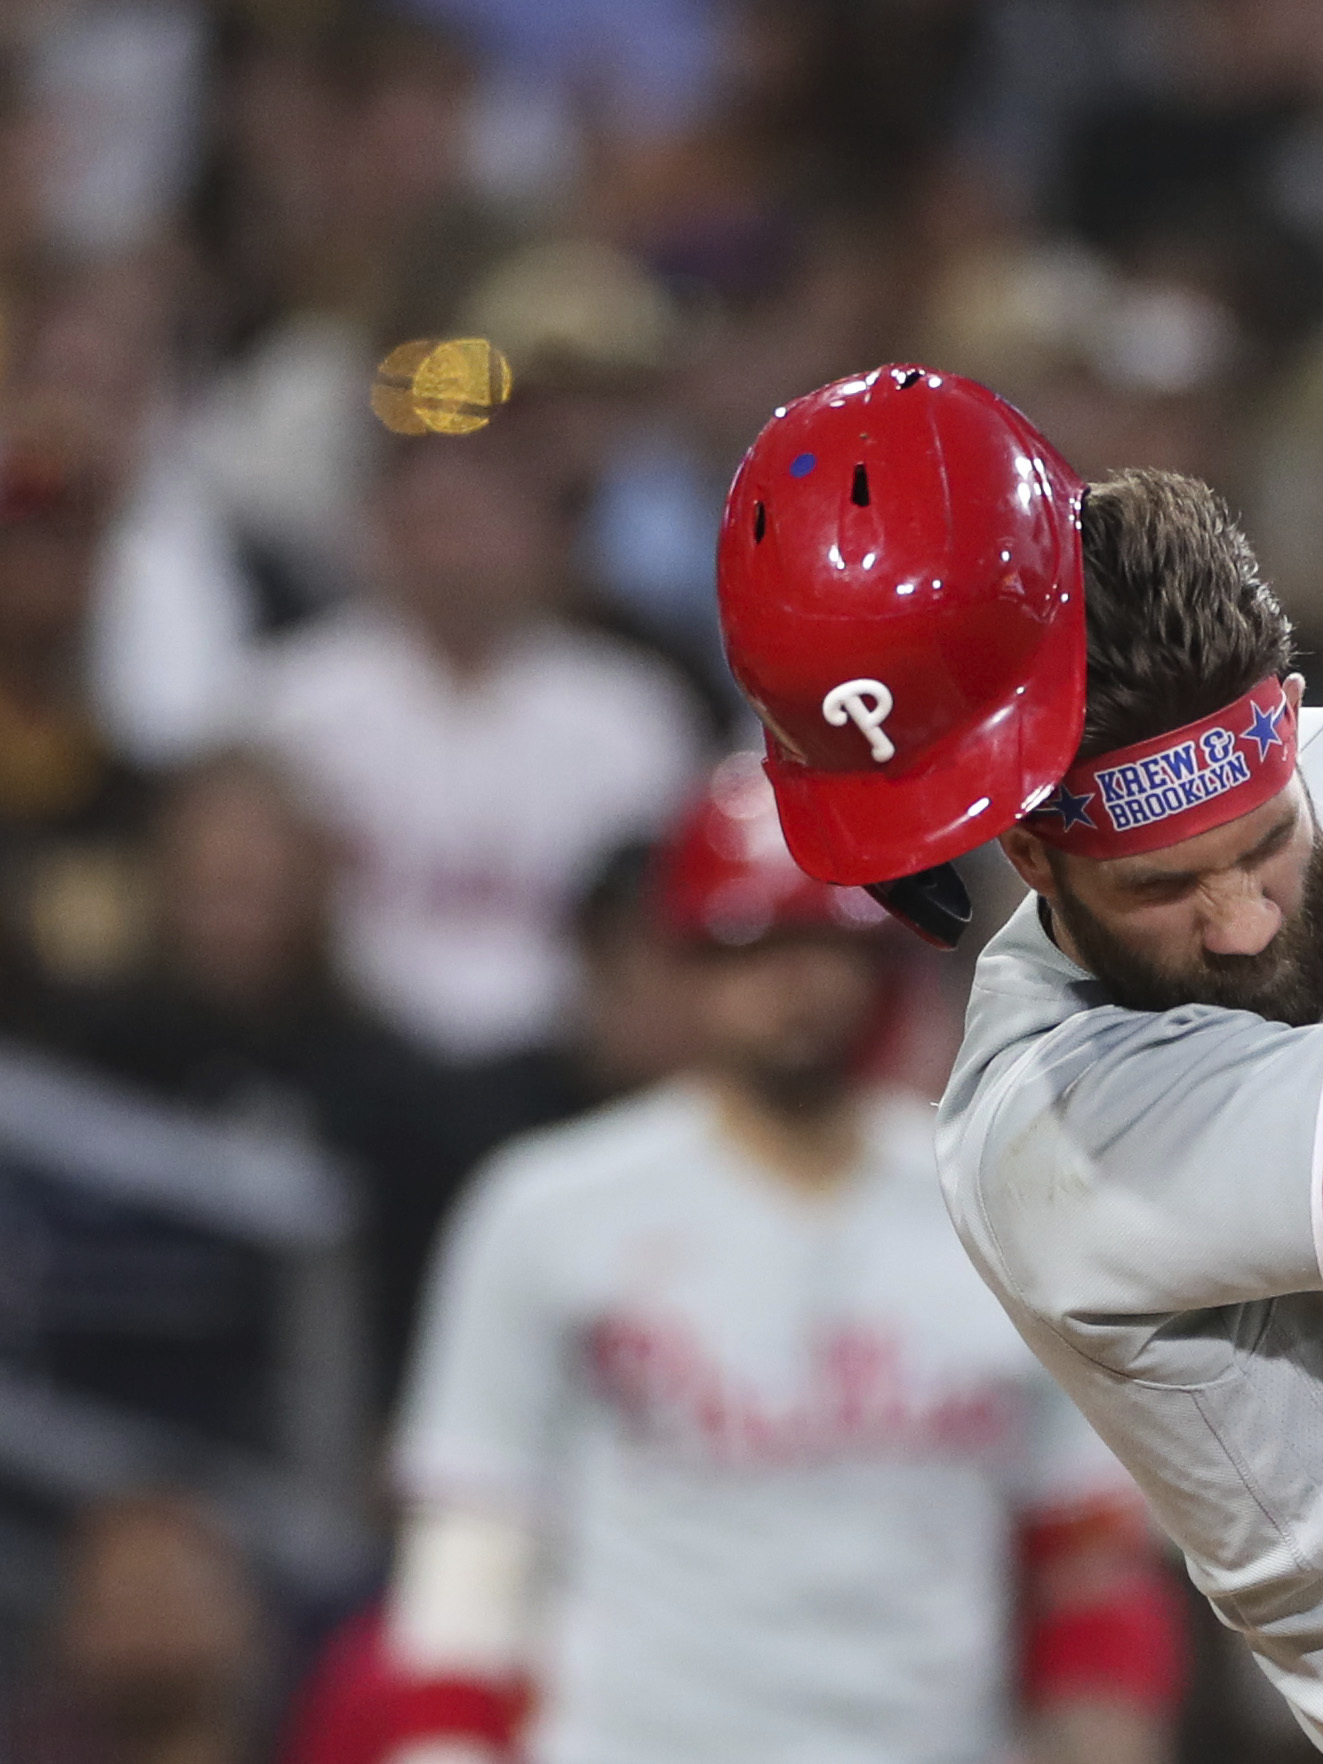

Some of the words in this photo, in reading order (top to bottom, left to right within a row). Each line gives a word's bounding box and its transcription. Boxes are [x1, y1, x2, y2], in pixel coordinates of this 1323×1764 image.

[822, 678, 895, 762] P
[1096, 742, 1197, 802] KREW
[1201, 728, 1234, 764] &
[1107, 753, 1249, 830] BROOKLYN
